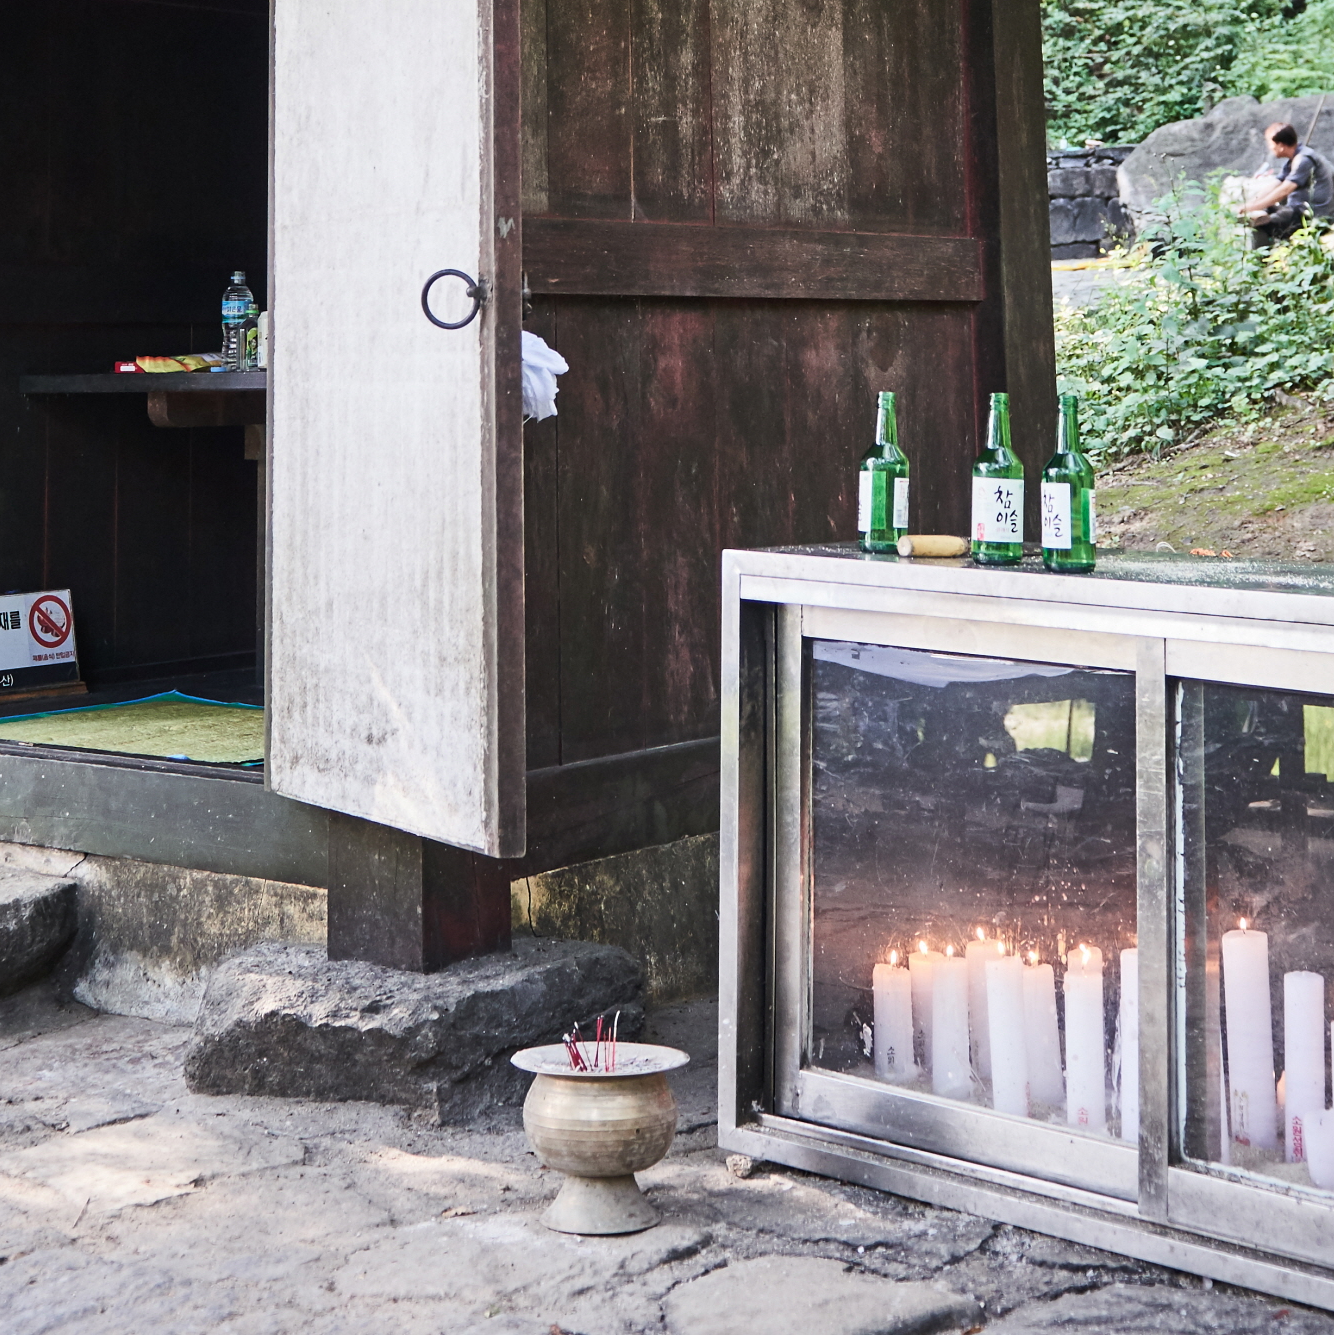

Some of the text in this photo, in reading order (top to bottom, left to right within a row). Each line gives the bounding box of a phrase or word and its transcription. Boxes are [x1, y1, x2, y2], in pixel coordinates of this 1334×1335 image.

[993, 485, 1014, 509] 참
[995, 509, 1019, 534] 이슬
[1044, 513, 1064, 538] 이슬
